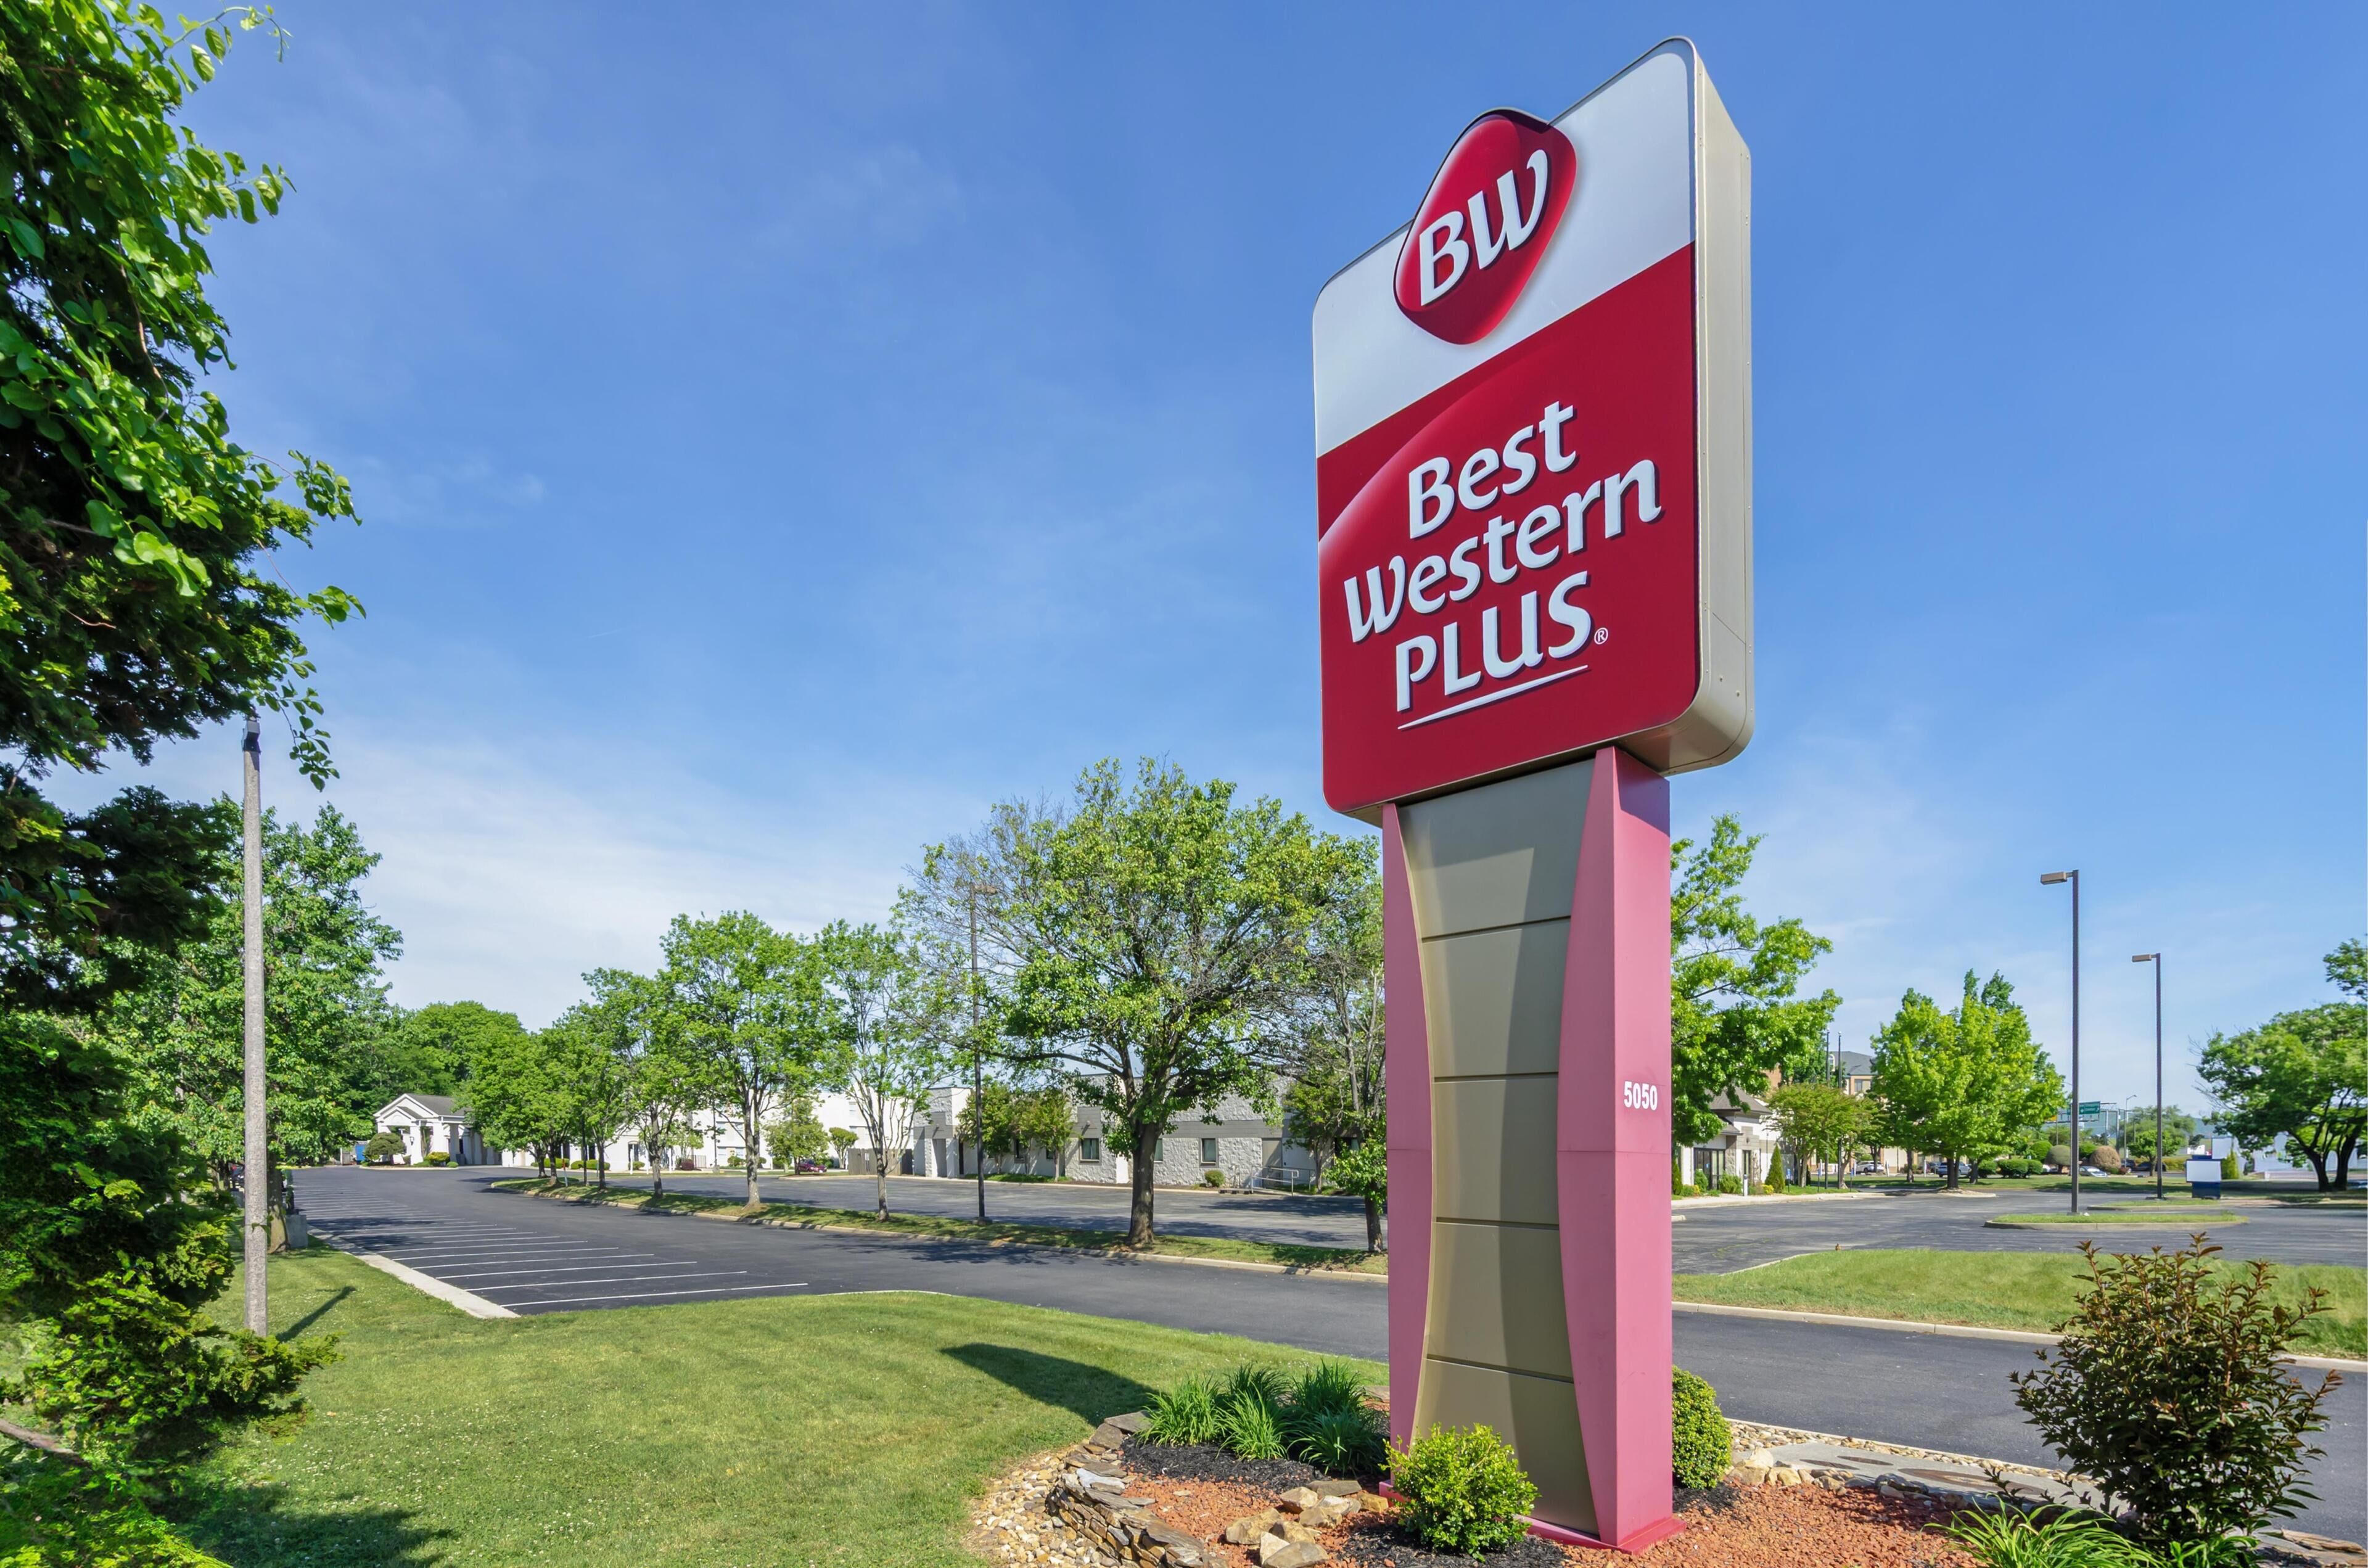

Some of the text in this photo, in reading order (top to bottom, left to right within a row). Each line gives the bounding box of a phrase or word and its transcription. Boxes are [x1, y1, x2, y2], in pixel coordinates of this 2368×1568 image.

[1419, 149, 1548, 306] BW
[1408, 401, 1576, 540] Best
[1344, 459, 1662, 642] Western
[1624, 1080, 1658, 1110] 5050
